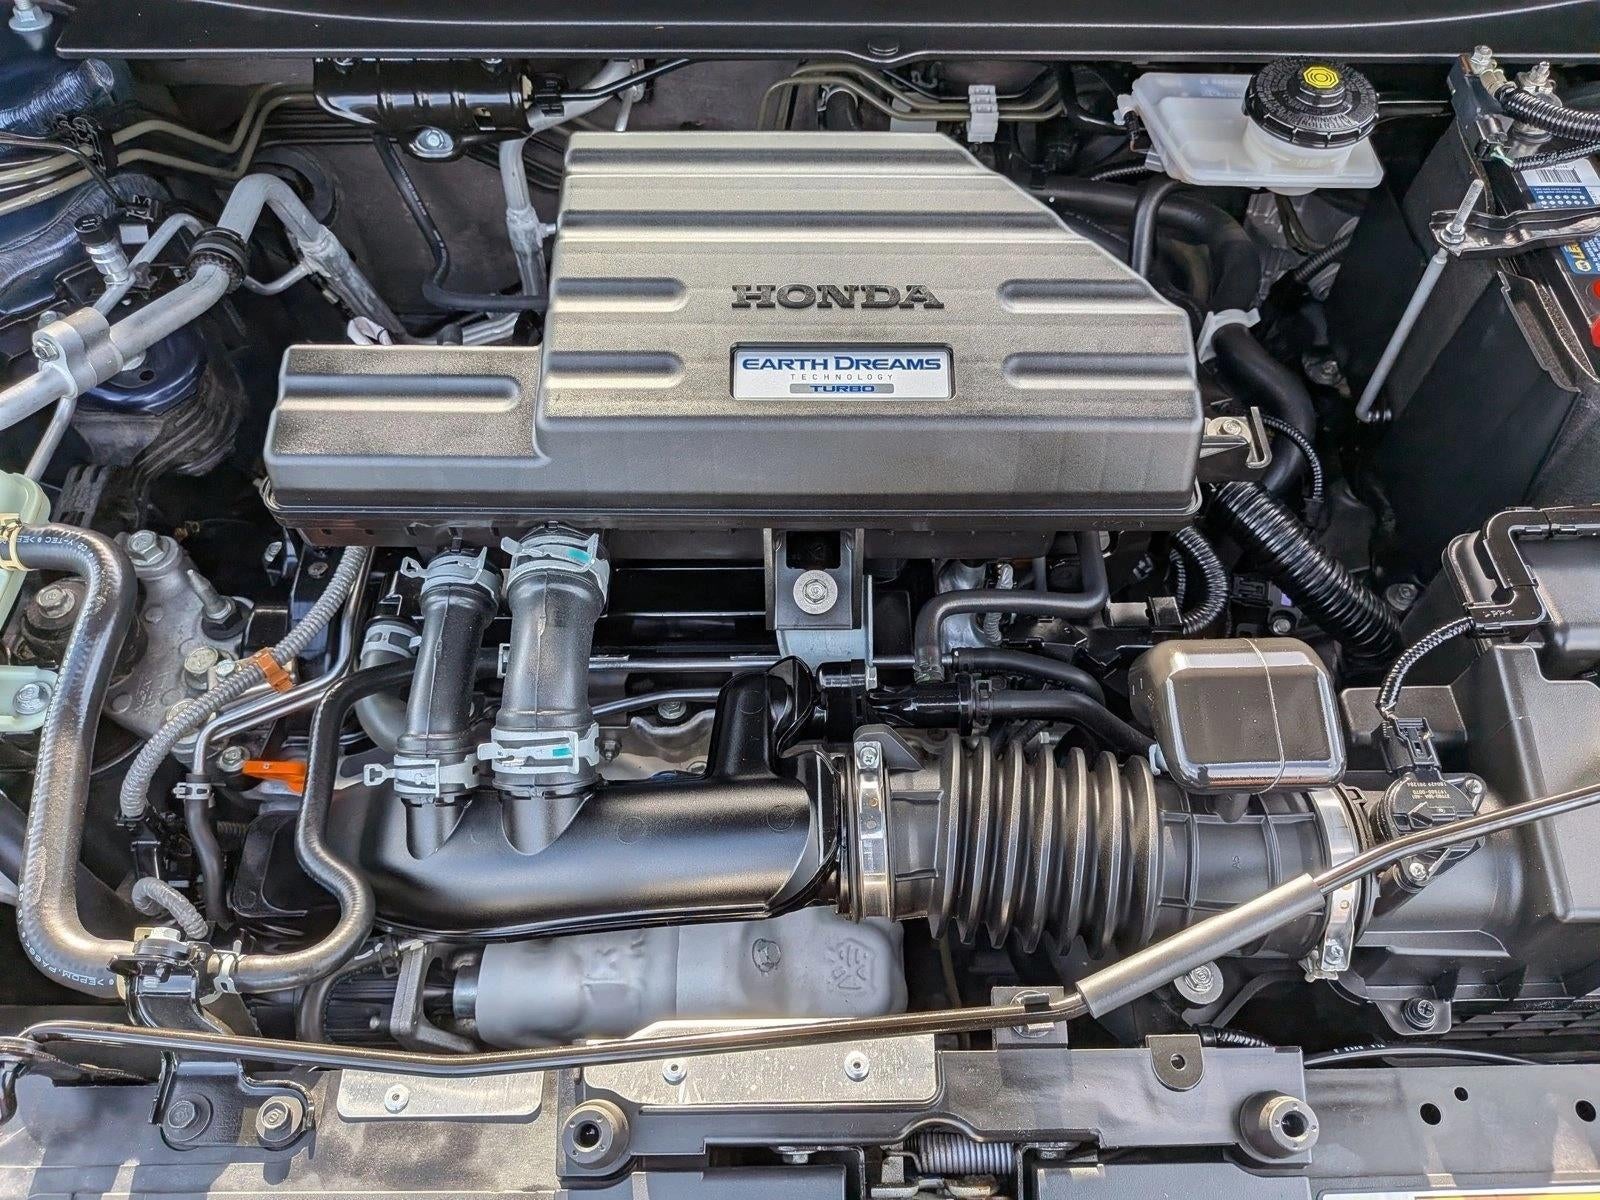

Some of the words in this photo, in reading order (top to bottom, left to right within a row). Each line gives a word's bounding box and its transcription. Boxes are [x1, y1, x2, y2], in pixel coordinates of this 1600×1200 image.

[731, 284, 945, 309] HONDA
[742, 358, 828, 370] EARTH
[834, 356, 941, 370] DREAMS
